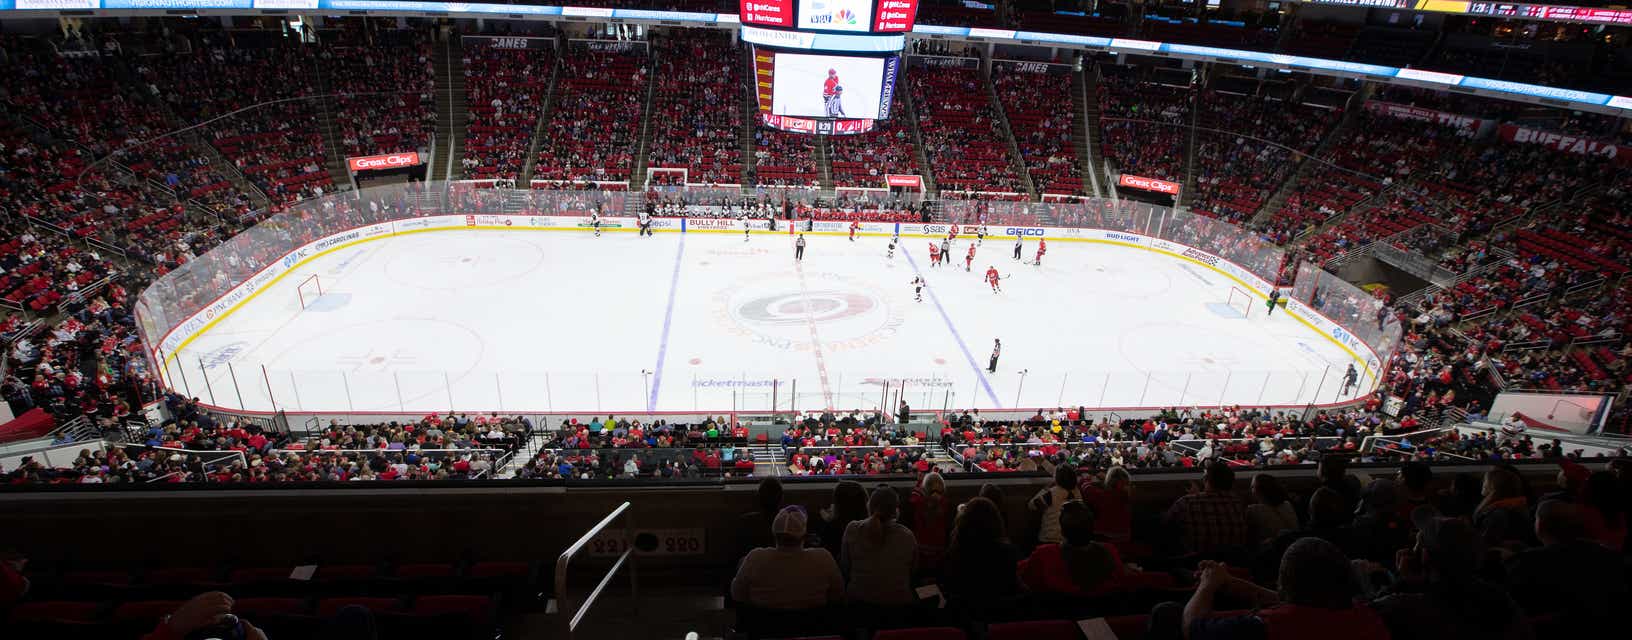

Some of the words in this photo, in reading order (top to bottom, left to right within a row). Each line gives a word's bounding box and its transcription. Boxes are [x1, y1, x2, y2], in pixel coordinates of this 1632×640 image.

[1513, 127, 1618, 159] BUFFALO
[356, 159, 387, 168] Great
[388, 155, 412, 166] Clips
[1151, 181, 1173, 192] Clips
[717, 219, 736, 227] HILL
[1006, 227, 1045, 237] GEICO
